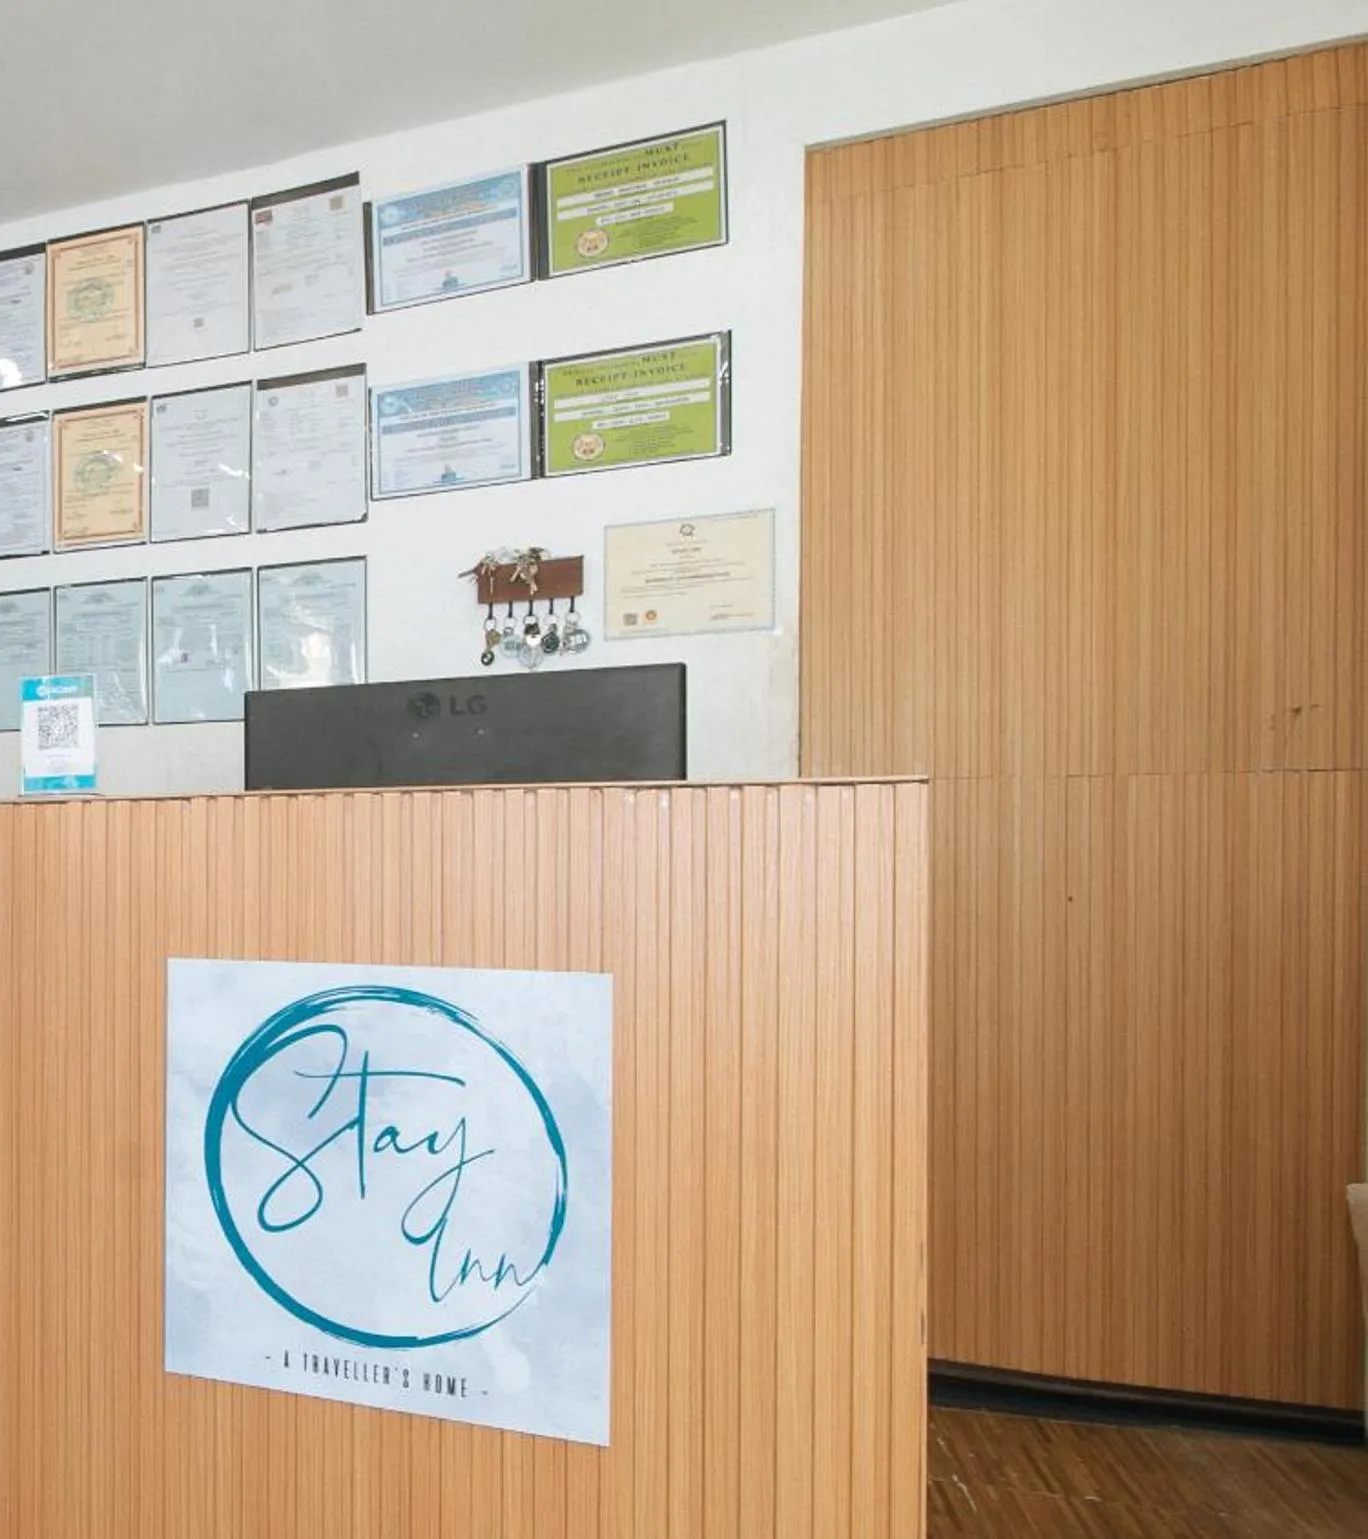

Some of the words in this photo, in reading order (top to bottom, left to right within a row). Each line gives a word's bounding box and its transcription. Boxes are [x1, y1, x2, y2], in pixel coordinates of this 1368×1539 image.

[450, 693, 488, 715] LG
[231, 1024, 494, 1244] Stay
[284, 1350, 290, 1368] A
[303, 1352, 410, 1389] TRAVELLER'S
[423, 1372, 468, 1398] HOME
